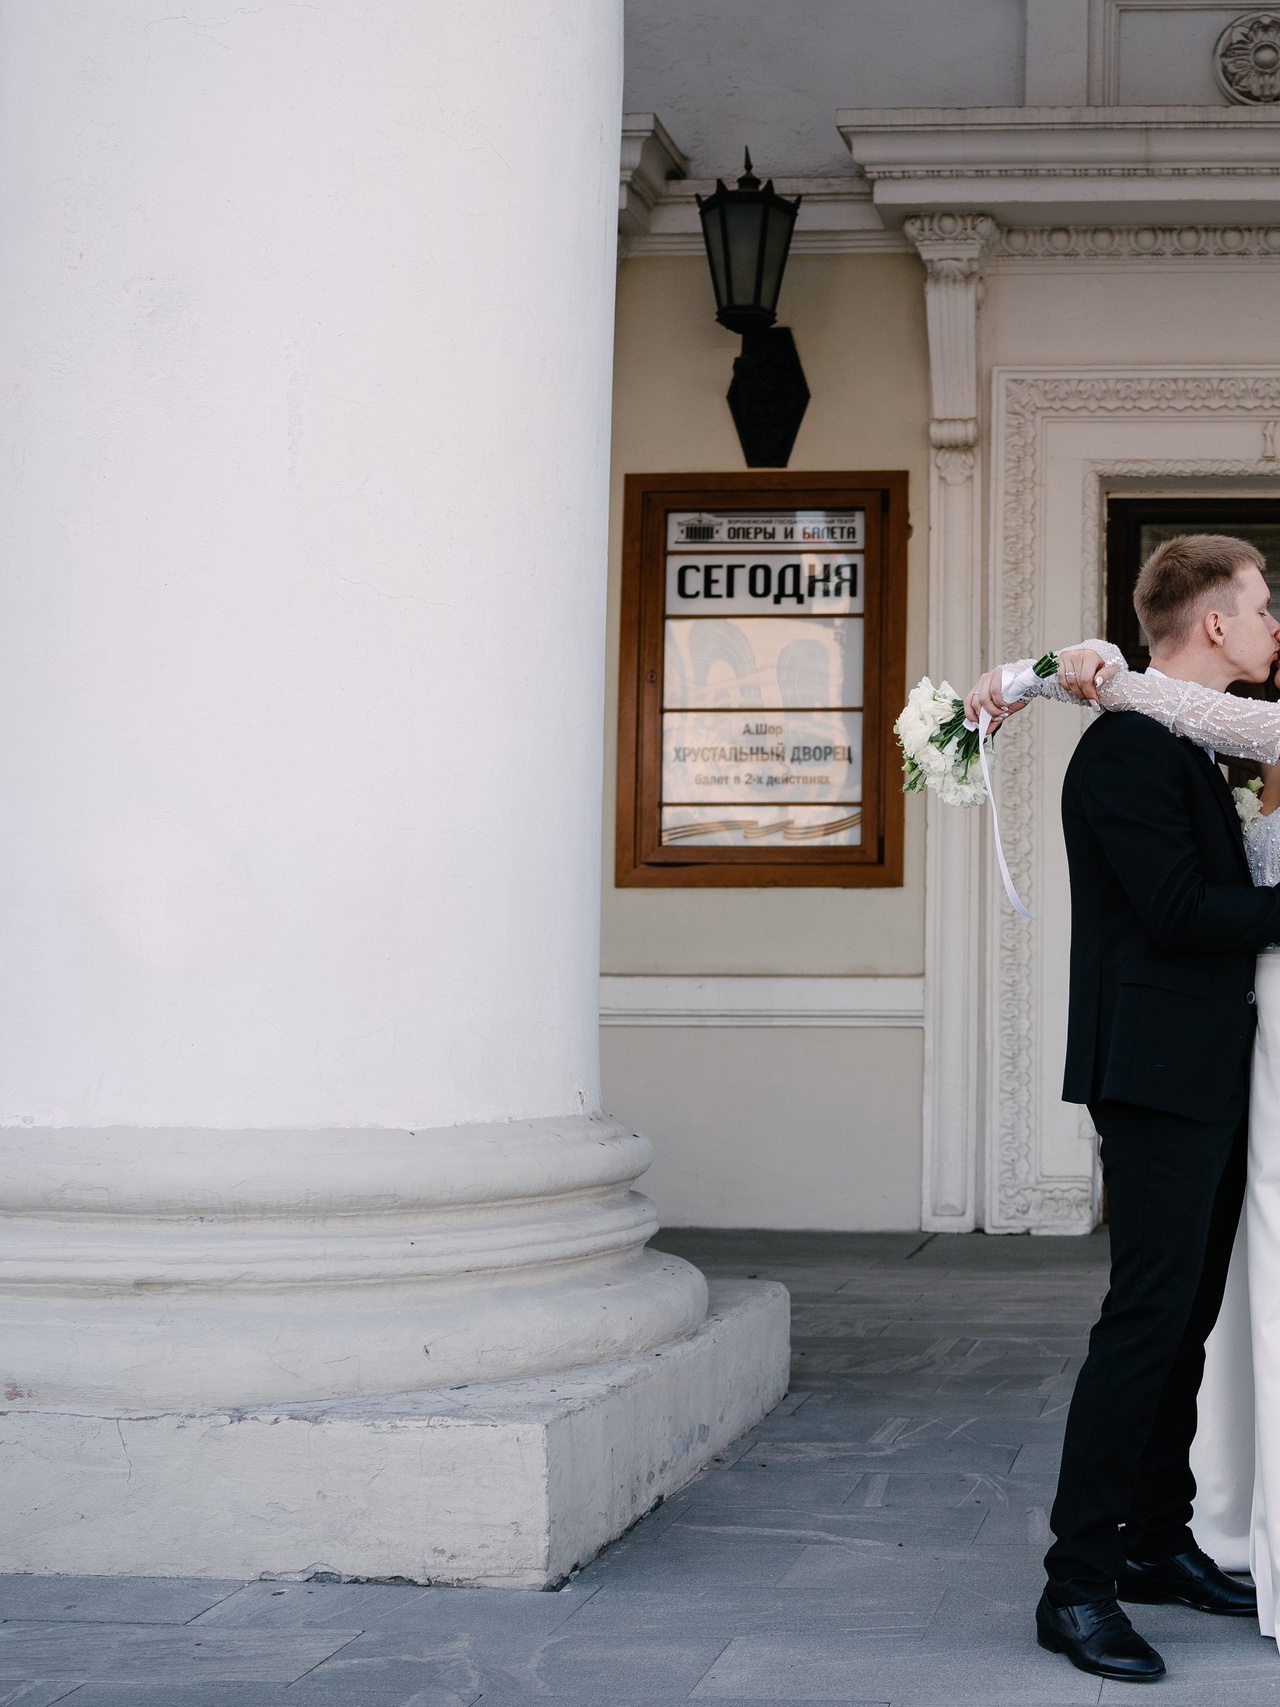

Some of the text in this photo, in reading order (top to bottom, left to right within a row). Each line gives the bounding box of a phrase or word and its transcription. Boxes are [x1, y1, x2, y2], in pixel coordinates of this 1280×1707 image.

[727, 526, 856, 540] ОПЕРЫ И БАЛЕТА
[677, 563, 858, 605] СЕГОДНЯ
[742, 723, 783, 737] А.Шор
[673, 743, 853, 765] ХРУСТАЛЬНЫЙ ДВОРЕЦ
[694, 773, 830, 787] балет в 2-х действиях
